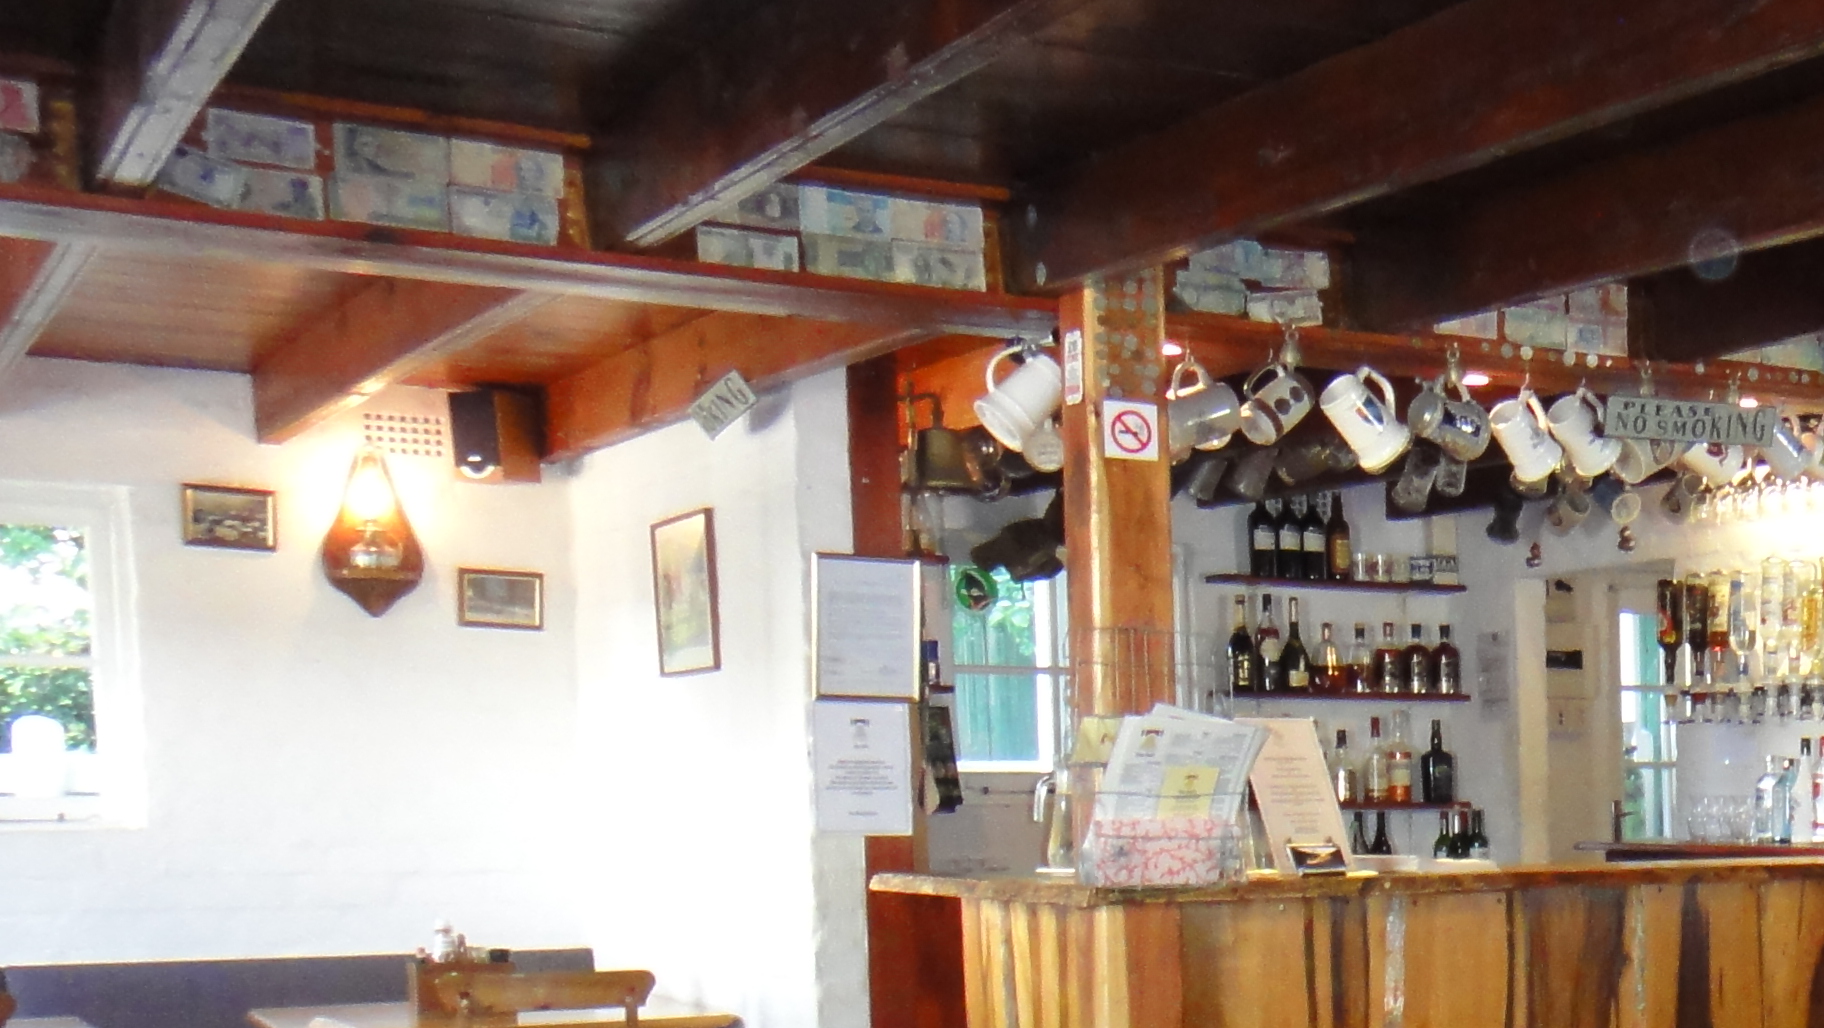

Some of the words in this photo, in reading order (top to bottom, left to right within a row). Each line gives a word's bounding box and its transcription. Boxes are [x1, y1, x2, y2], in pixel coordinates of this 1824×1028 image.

[1623, 401, 1713, 419] PLEASE
[1614, 411, 1647, 434] NO
[1657, 408, 1766, 442] SMOKING
